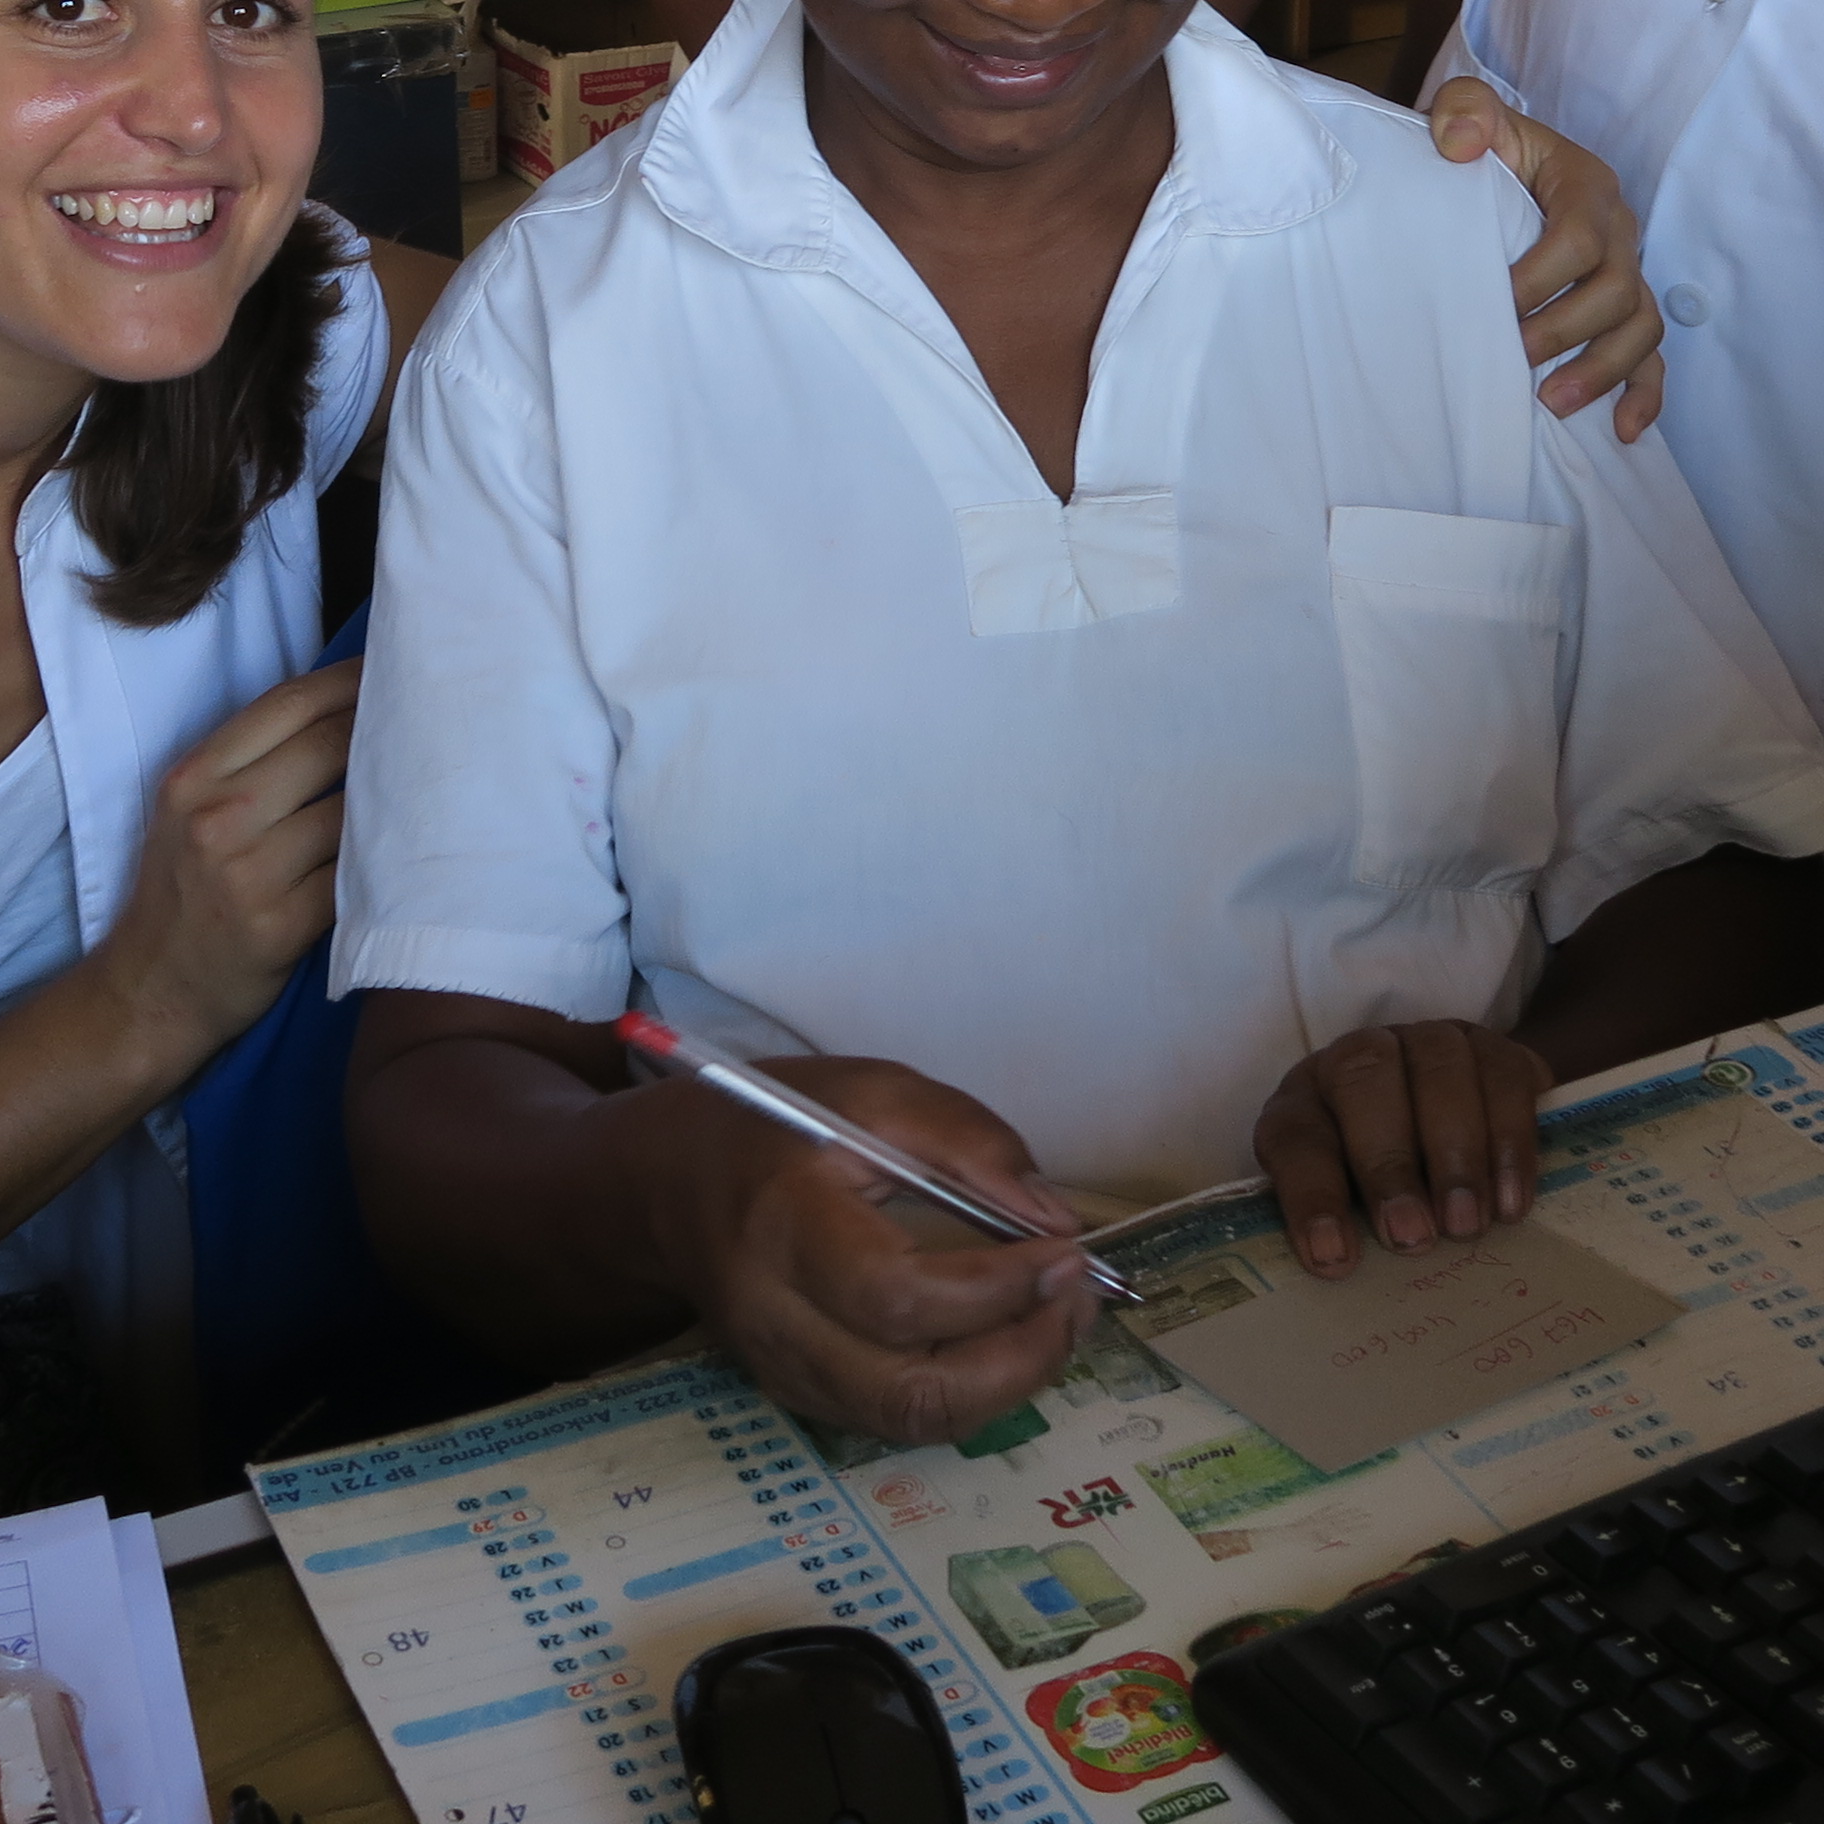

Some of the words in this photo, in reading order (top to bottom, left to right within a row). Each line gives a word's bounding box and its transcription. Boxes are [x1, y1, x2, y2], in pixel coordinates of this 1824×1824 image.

[583, 70, 630, 84] Savon
[635, 1385, 684, 1414] 222
[437, 1408, 612, 1473] Ankorondrano
[463, 1424, 493, 1446] du
[765, 1440, 772, 1450] J
[371, 1443, 402, 1465] au
[723, 1448, 745, 1460] 29
[305, 1450, 364, 1477] Ven.
[777, 1458, 793, 1469] M
[266, 1467, 299, 1490] de
[380, 1460, 416, 1486] BP
[739, 1468, 761, 1481] 28
[329, 1468, 377, 1497] 721
[792, 1480, 809, 1492] M
[499, 1488, 513, 1500] L
[614, 1485, 654, 1509] 44
[755, 1490, 776, 1503] 27
[458, 1498, 481, 1512] 30
[809, 1503, 821, 1513] L
[512, 1510, 527, 1522] D
[770, 1511, 793, 1525] 26
[472, 1518, 495, 1532] 29
[825, 1524, 839, 1535] D
[527, 1532, 541, 1544] S
[785, 1534, 807, 1547] 25
[484, 1542, 508, 1554] 28
[842, 1546, 854, 1558] S
[539, 1555, 555, 1568] V
[801, 1557, 824, 1570] 24
[498, 1564, 522, 1578] 27
[859, 1569, 874, 1581] V
[554, 1577, 564, 1589] J
[817, 1580, 840, 1593] 23
[511, 1586, 535, 1600] 26
[875, 1593, 884, 1604] J
[567, 1600, 586, 1613] M
[834, 1603, 857, 1617] 22
[525, 1609, 549, 1624] 25
[890, 1615, 907, 1627] M
[580, 1623, 600, 1637] M
[388, 1628, 430, 1652] 48
[538, 1633, 564, 1648] 24
[907, 1639, 925, 1650] M
[599, 1647, 612, 1660] L
[552, 1657, 577, 1672] 23
[927, 1664, 939, 1675] L
[612, 1672, 628, 1685] D
[568, 1682, 591, 1696] 22
[945, 1688, 960, 1699] D
[628, 1698, 642, 1710] S
[585, 1708, 609, 1722] 21
[962, 1713, 976, 1726] S
[642, 1724, 659, 1739] V
[598, 1734, 623, 1749] 20
[982, 1739, 997, 1752] V
[658, 1750, 669, 1762] J
[614, 1760, 638, 1775] 19
[1001, 1766, 1011, 1776] J
[629, 1787, 654, 1801] 18
[1018, 1790, 1036, 1804] M
[1144, 1783, 1226, 1823] blédina
[976, 1803, 1000, 1819] 14
